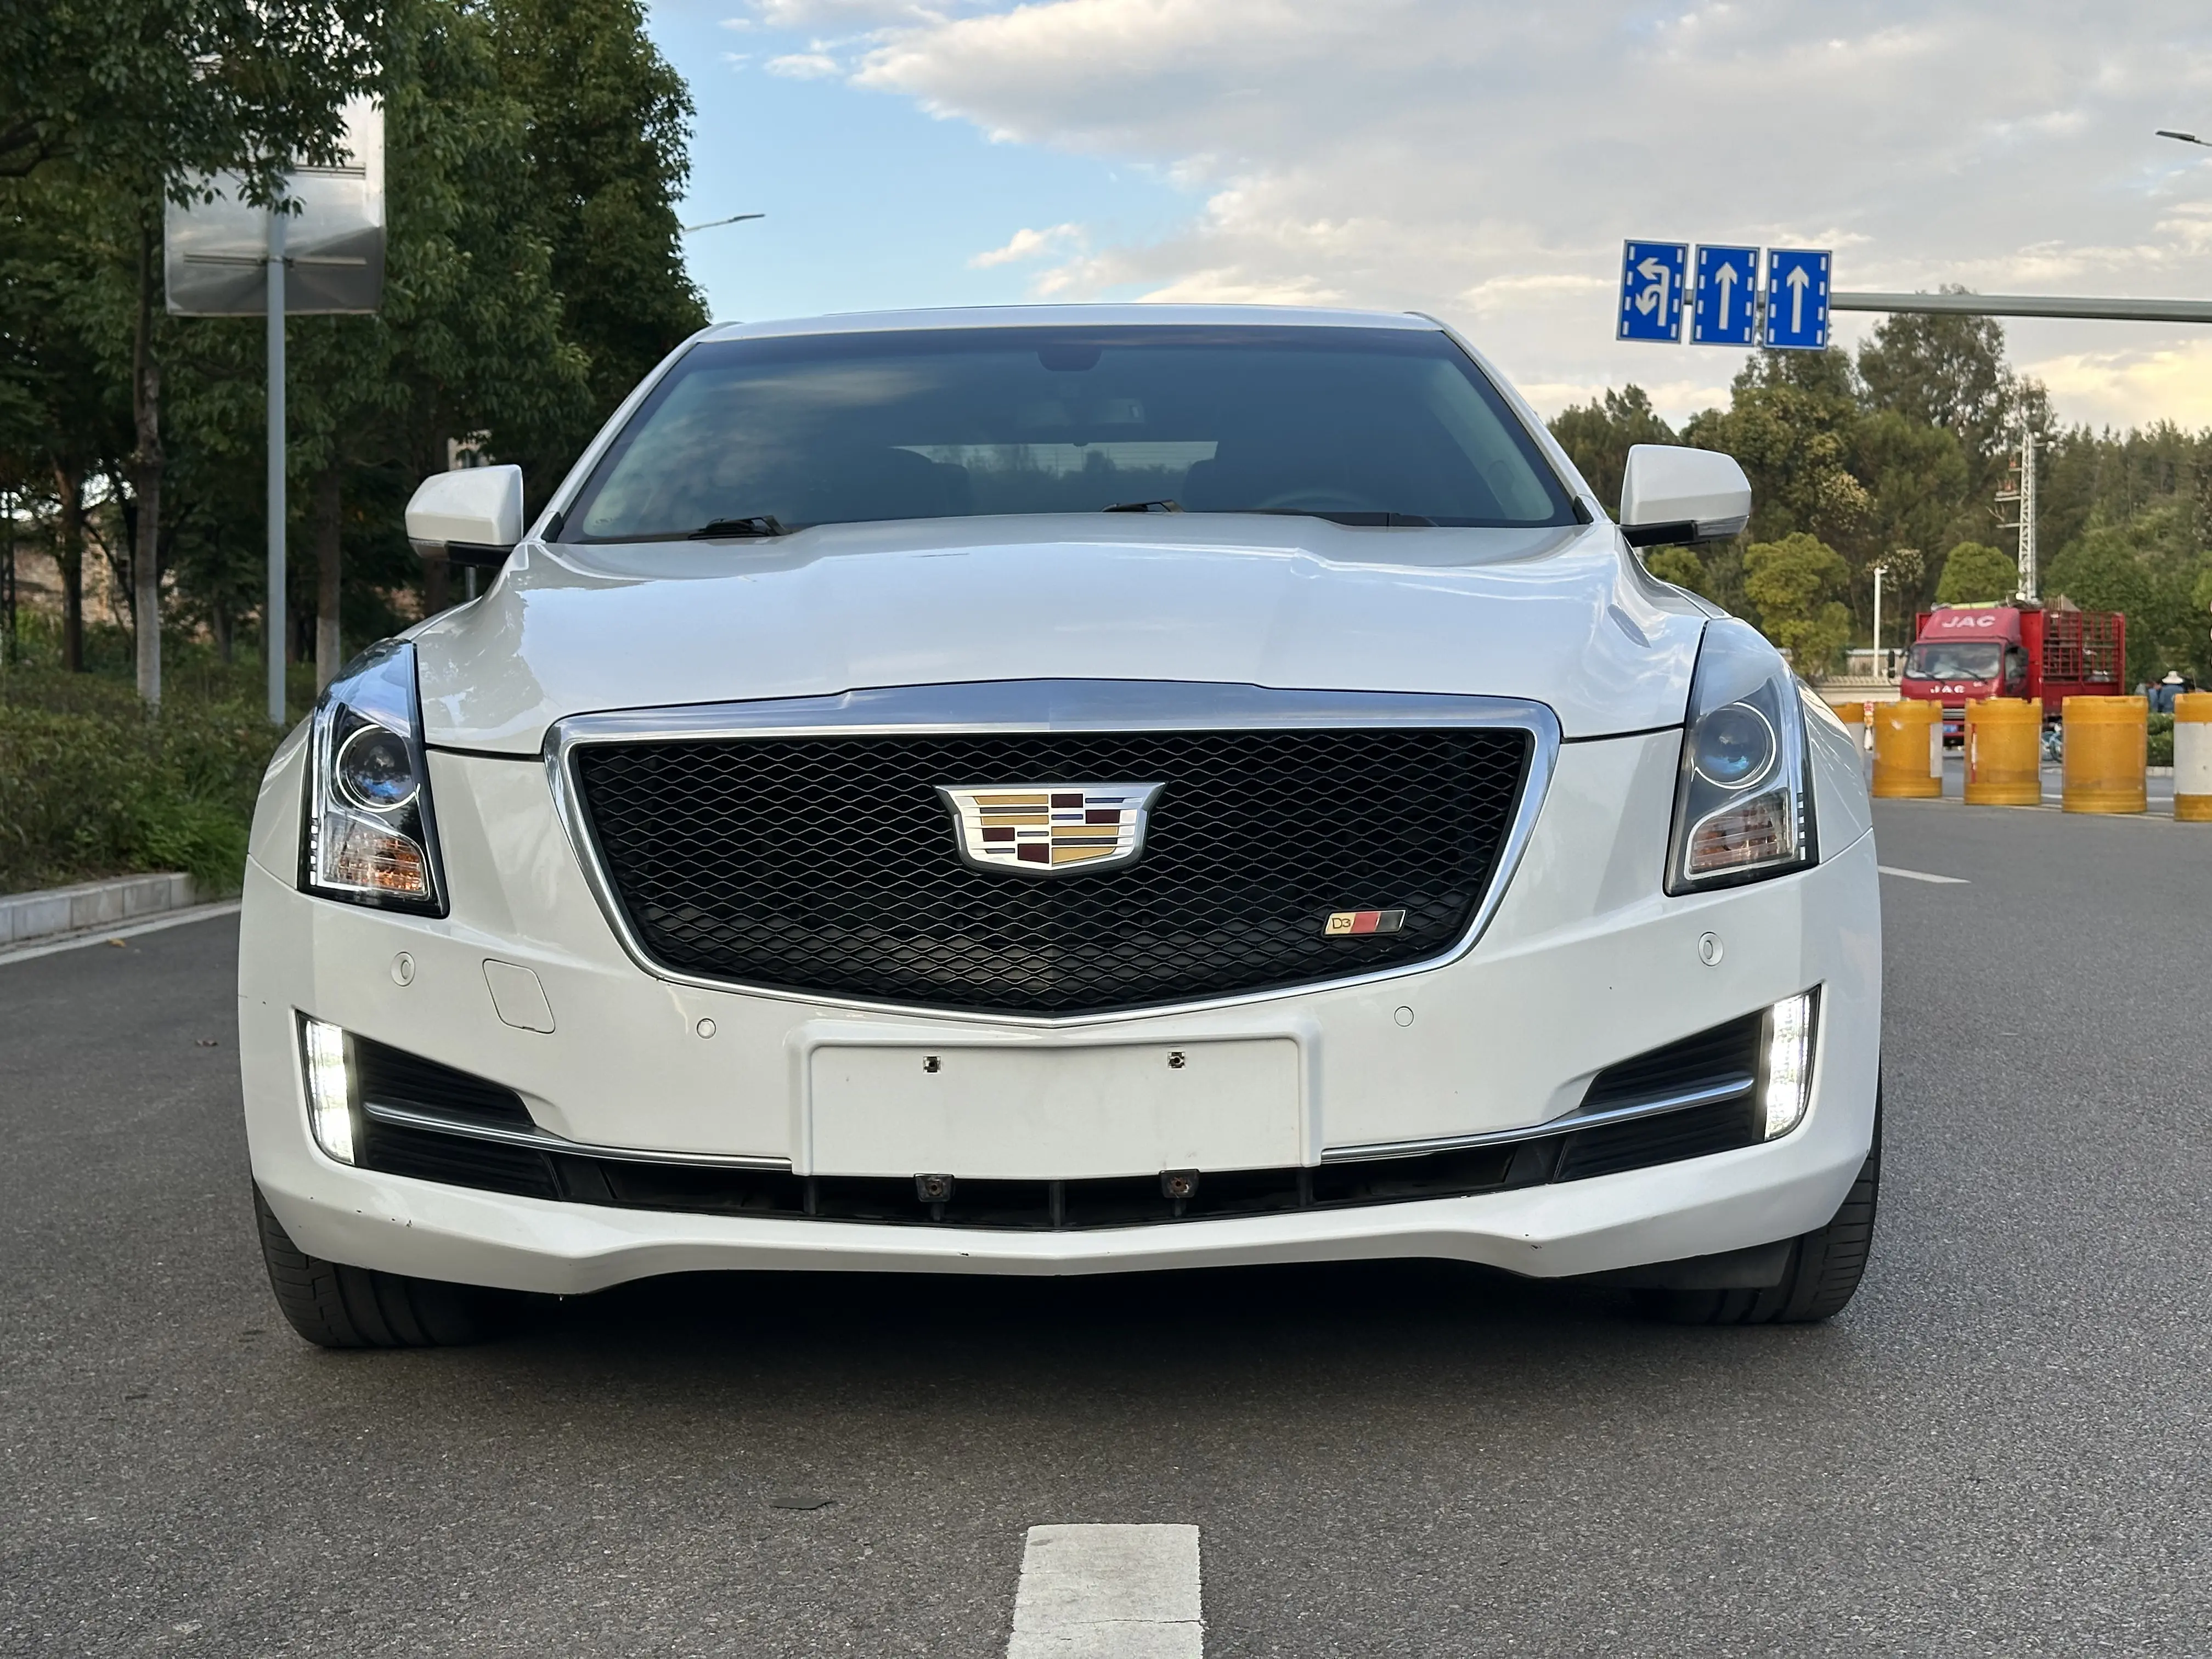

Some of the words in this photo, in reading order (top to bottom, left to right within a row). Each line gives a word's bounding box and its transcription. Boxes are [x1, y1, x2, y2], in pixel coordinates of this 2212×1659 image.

[1942, 615, 1995, 628] JAC
[1930, 685, 1965, 693] JAC
[1332, 917, 1351, 929] D3
